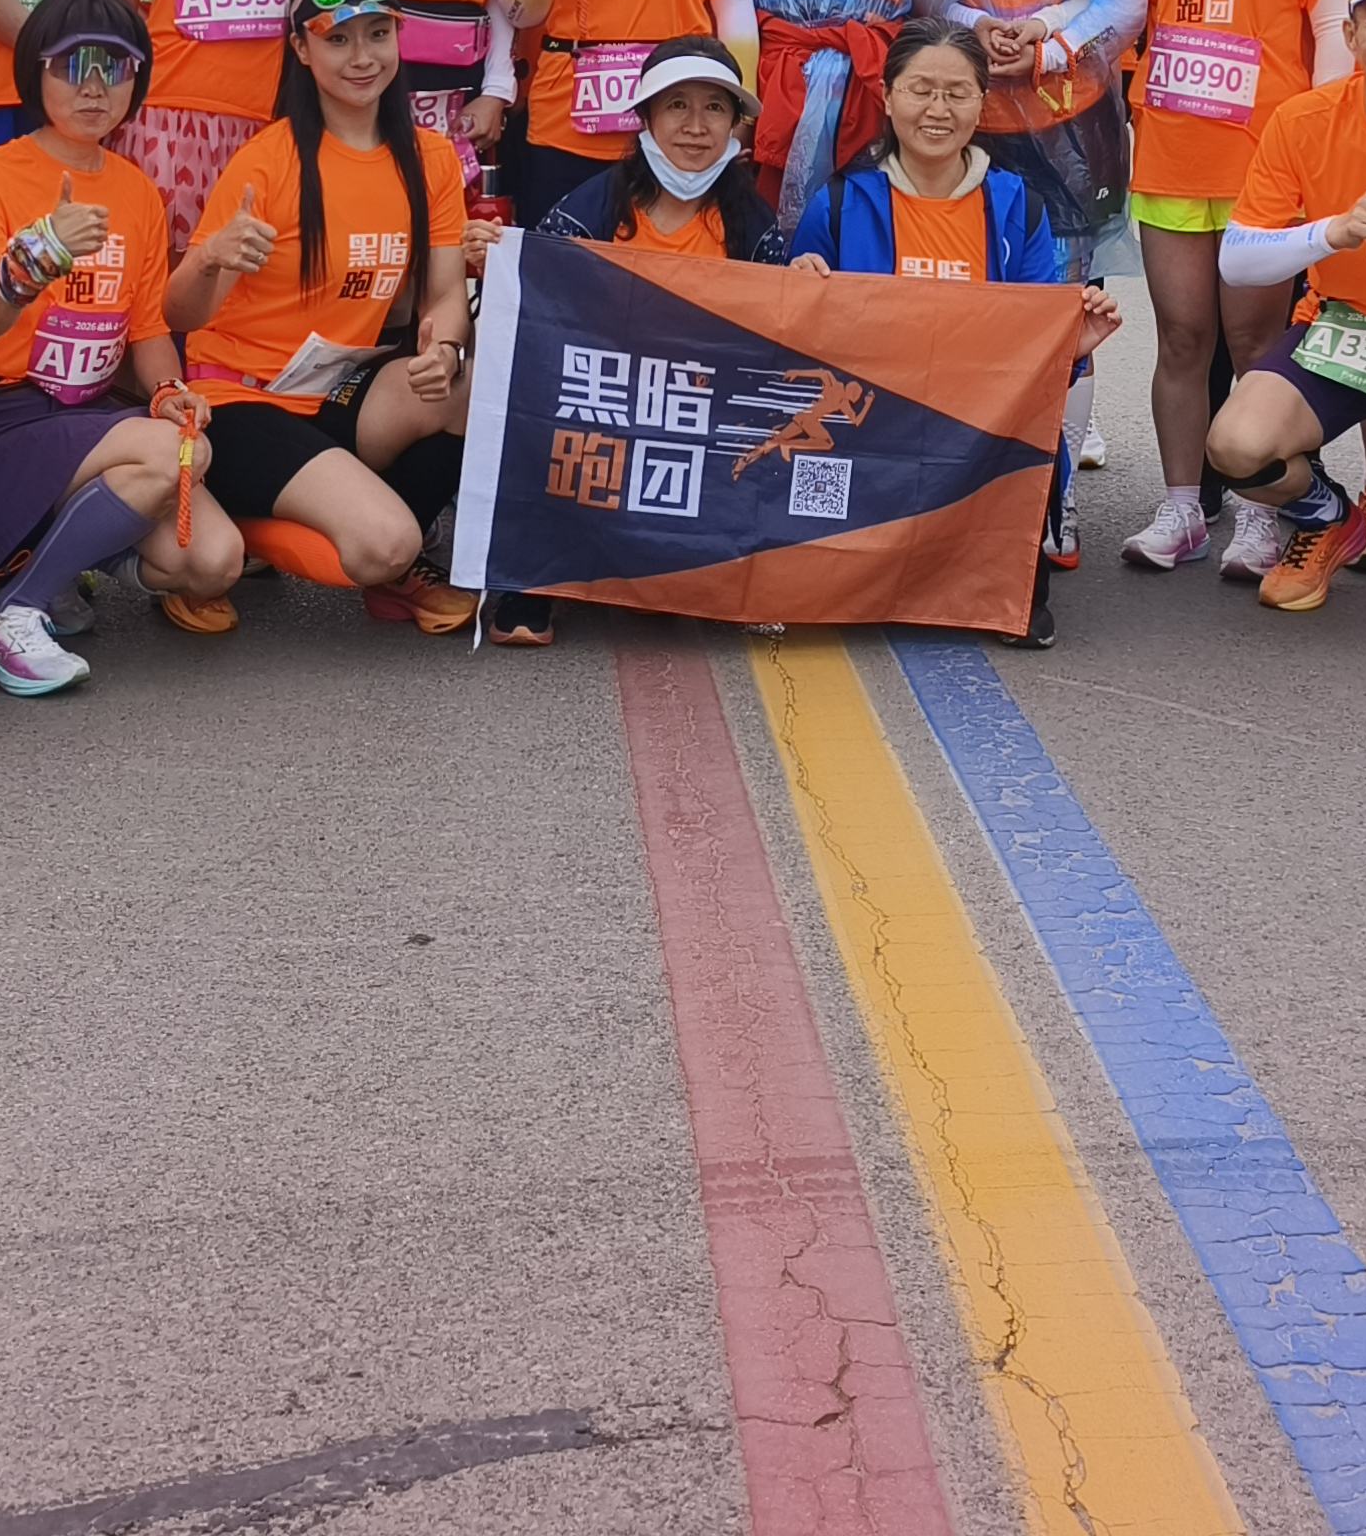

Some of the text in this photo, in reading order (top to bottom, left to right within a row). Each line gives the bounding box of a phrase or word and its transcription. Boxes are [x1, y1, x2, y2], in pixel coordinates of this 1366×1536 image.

[73, 234, 125, 268] 暗
[348, 231, 408, 267] 黑暗
[339, 266, 406, 301] 跑团
[901, 256, 971, 281] 黑暗
[65, 271, 123, 305] 跑团
[555, 344, 717, 438] 黑暗
[545, 429, 705, 519] 跑团
